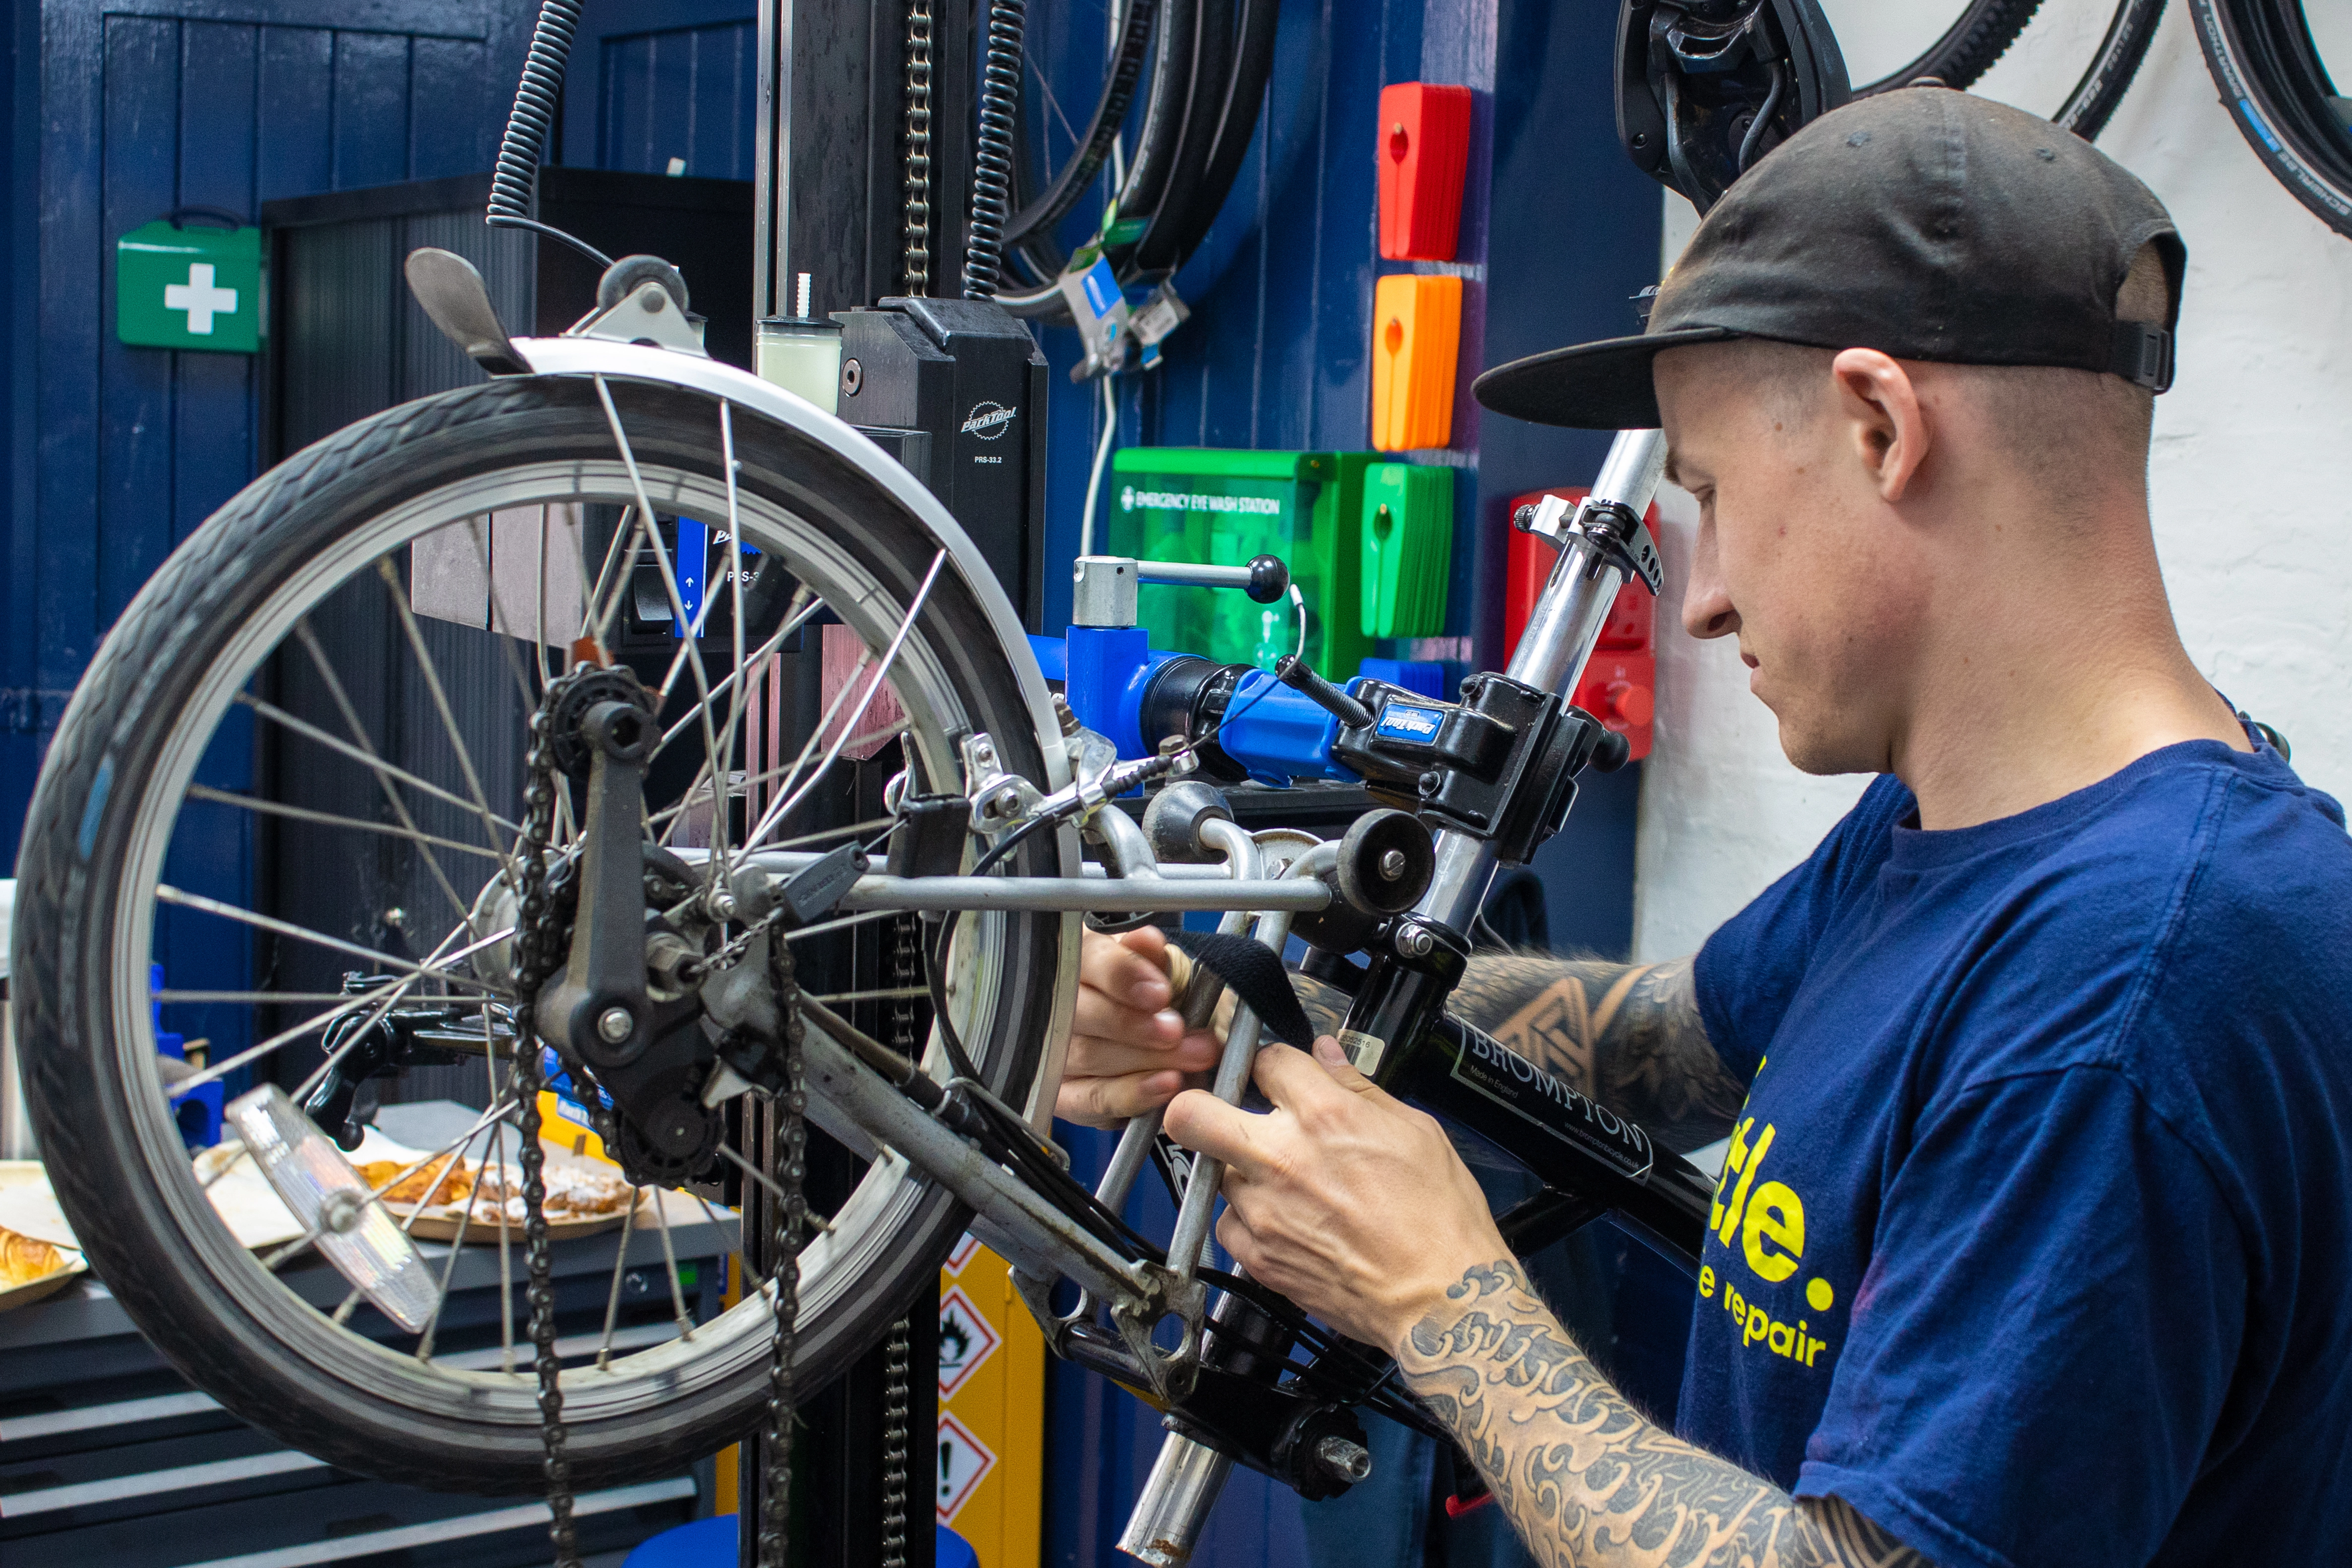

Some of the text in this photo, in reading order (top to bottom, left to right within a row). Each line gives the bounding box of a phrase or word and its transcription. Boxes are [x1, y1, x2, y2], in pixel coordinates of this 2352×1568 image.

[2203, 13, 2244, 98] MARATHON
[1136, 491, 1280, 515] EMERGENCY EYE WASH STATION
[1470, 1065, 1518, 1098] Made in England
[1472, 1030, 1643, 1151] BROMPTON
[1724, 1281, 1826, 1368] repair
